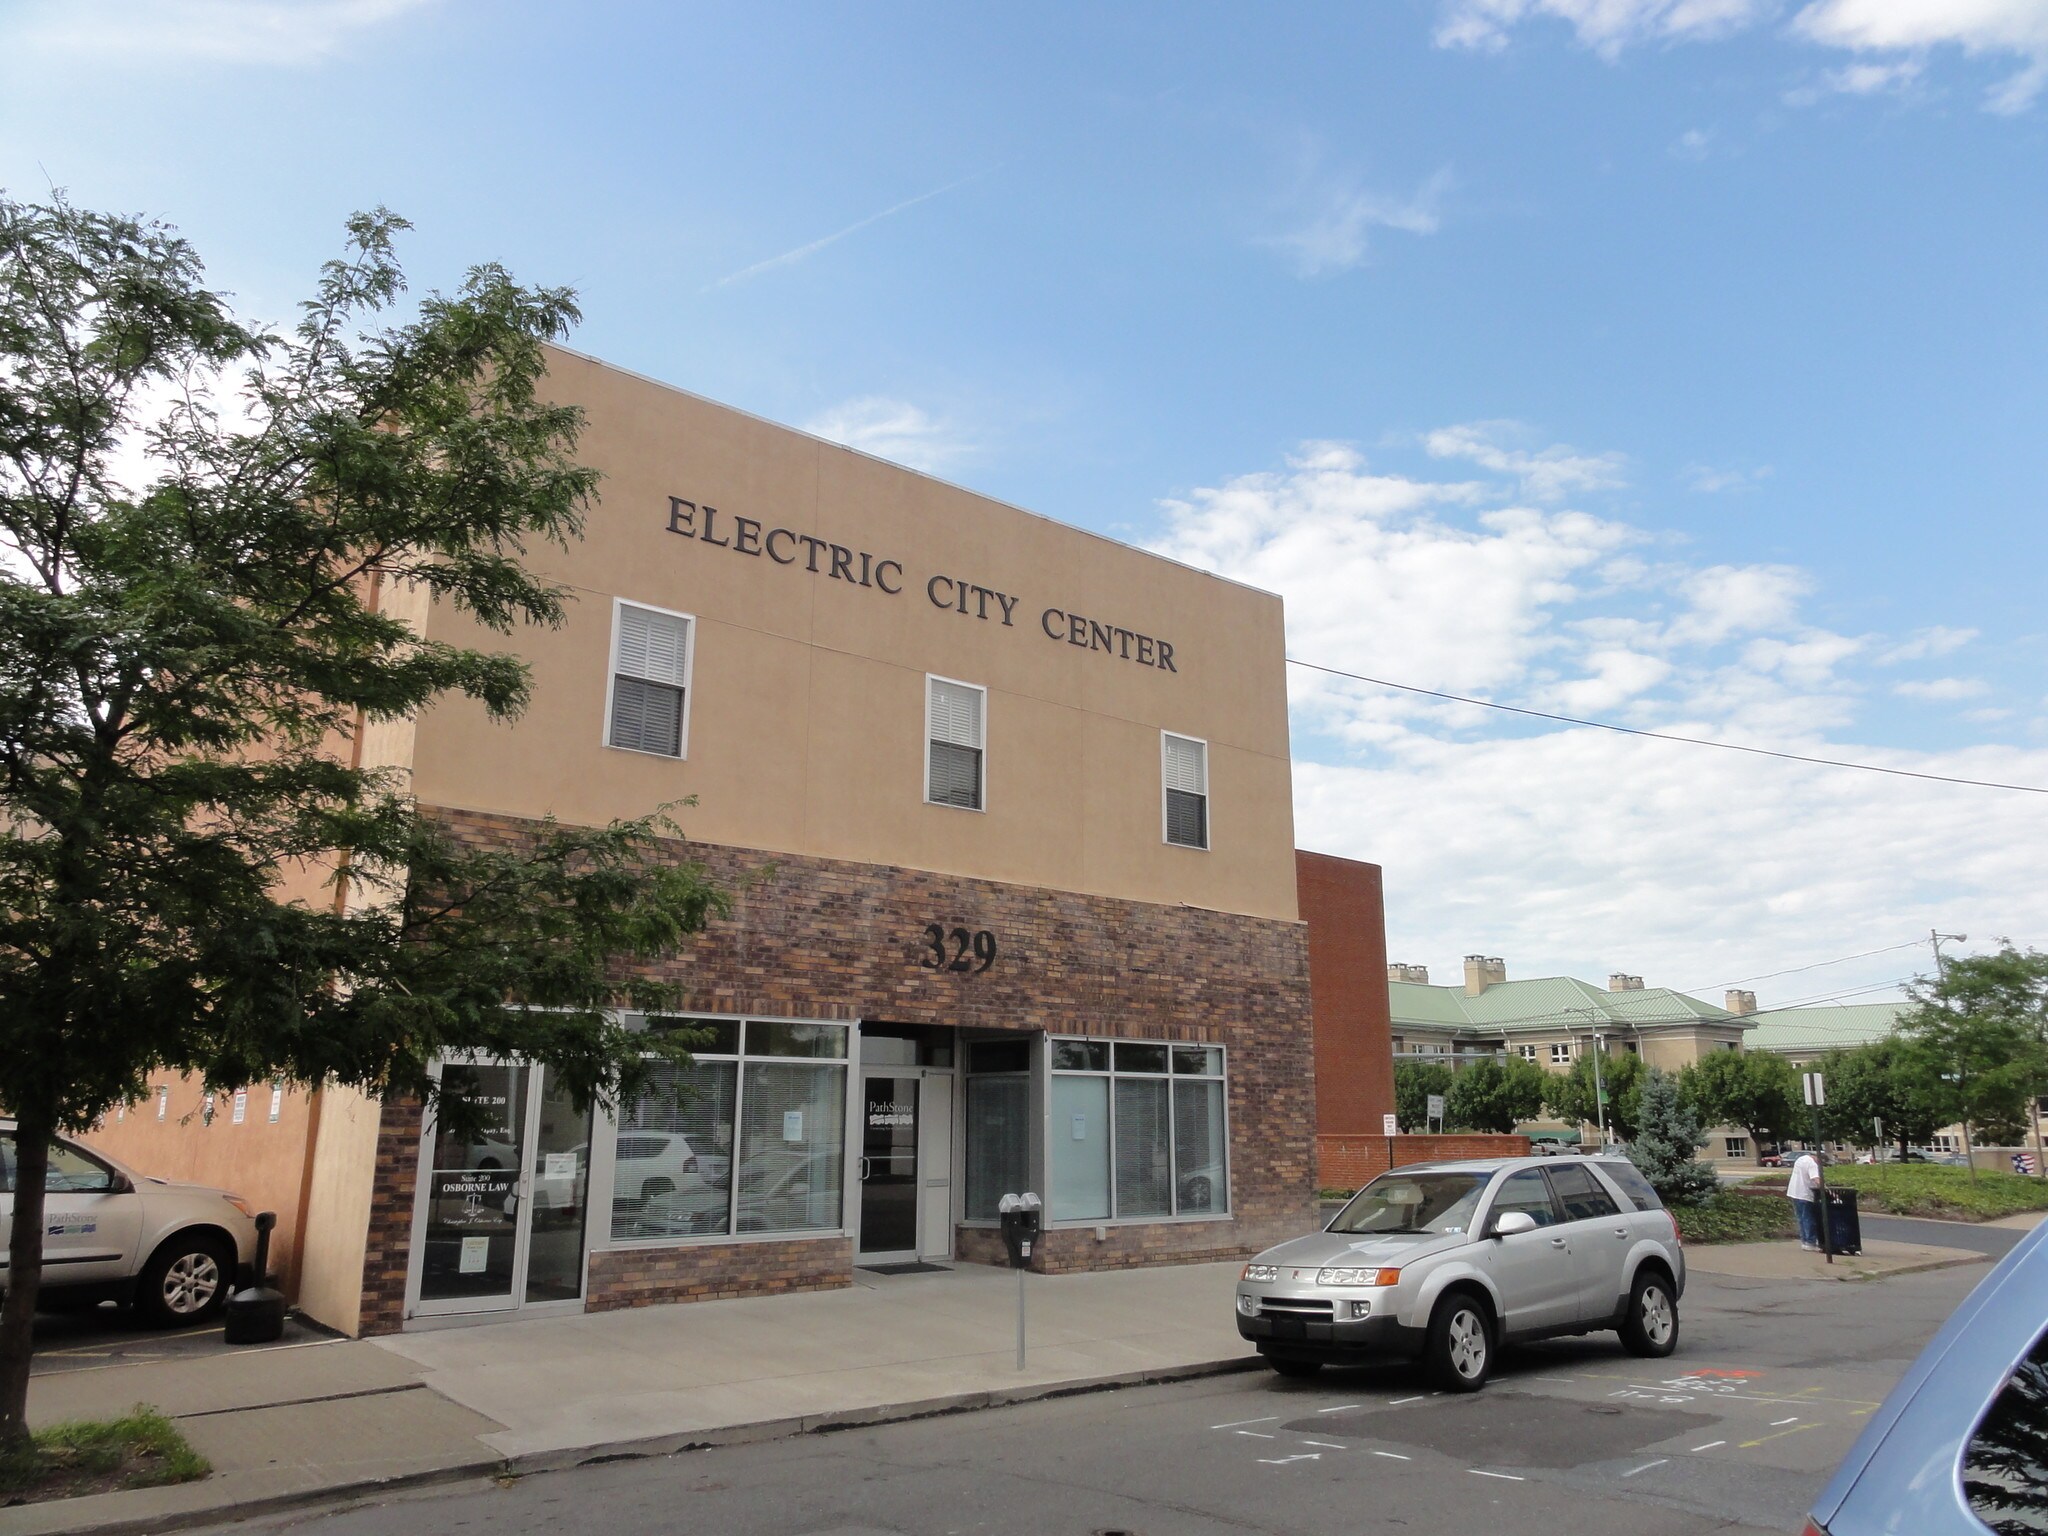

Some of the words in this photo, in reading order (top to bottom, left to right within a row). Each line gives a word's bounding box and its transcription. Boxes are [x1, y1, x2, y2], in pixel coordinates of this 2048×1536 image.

[665, 495, 903, 595] ELECTRIC
[927, 575, 1019, 627] CITY
[1041, 608, 1178, 673] CENTER
[922, 923, 997, 973] 329
[492, 1096, 506, 1105] 200
[869, 1101, 914, 1113] PathStone
[461, 1174, 477, 1182] Suite
[478, 1174, 491, 1182] 200
[442, 1183, 487, 1192] OSBORNE
[488, 1183, 509, 1191] LAW
[49, 1212, 98, 1223] PathStone
